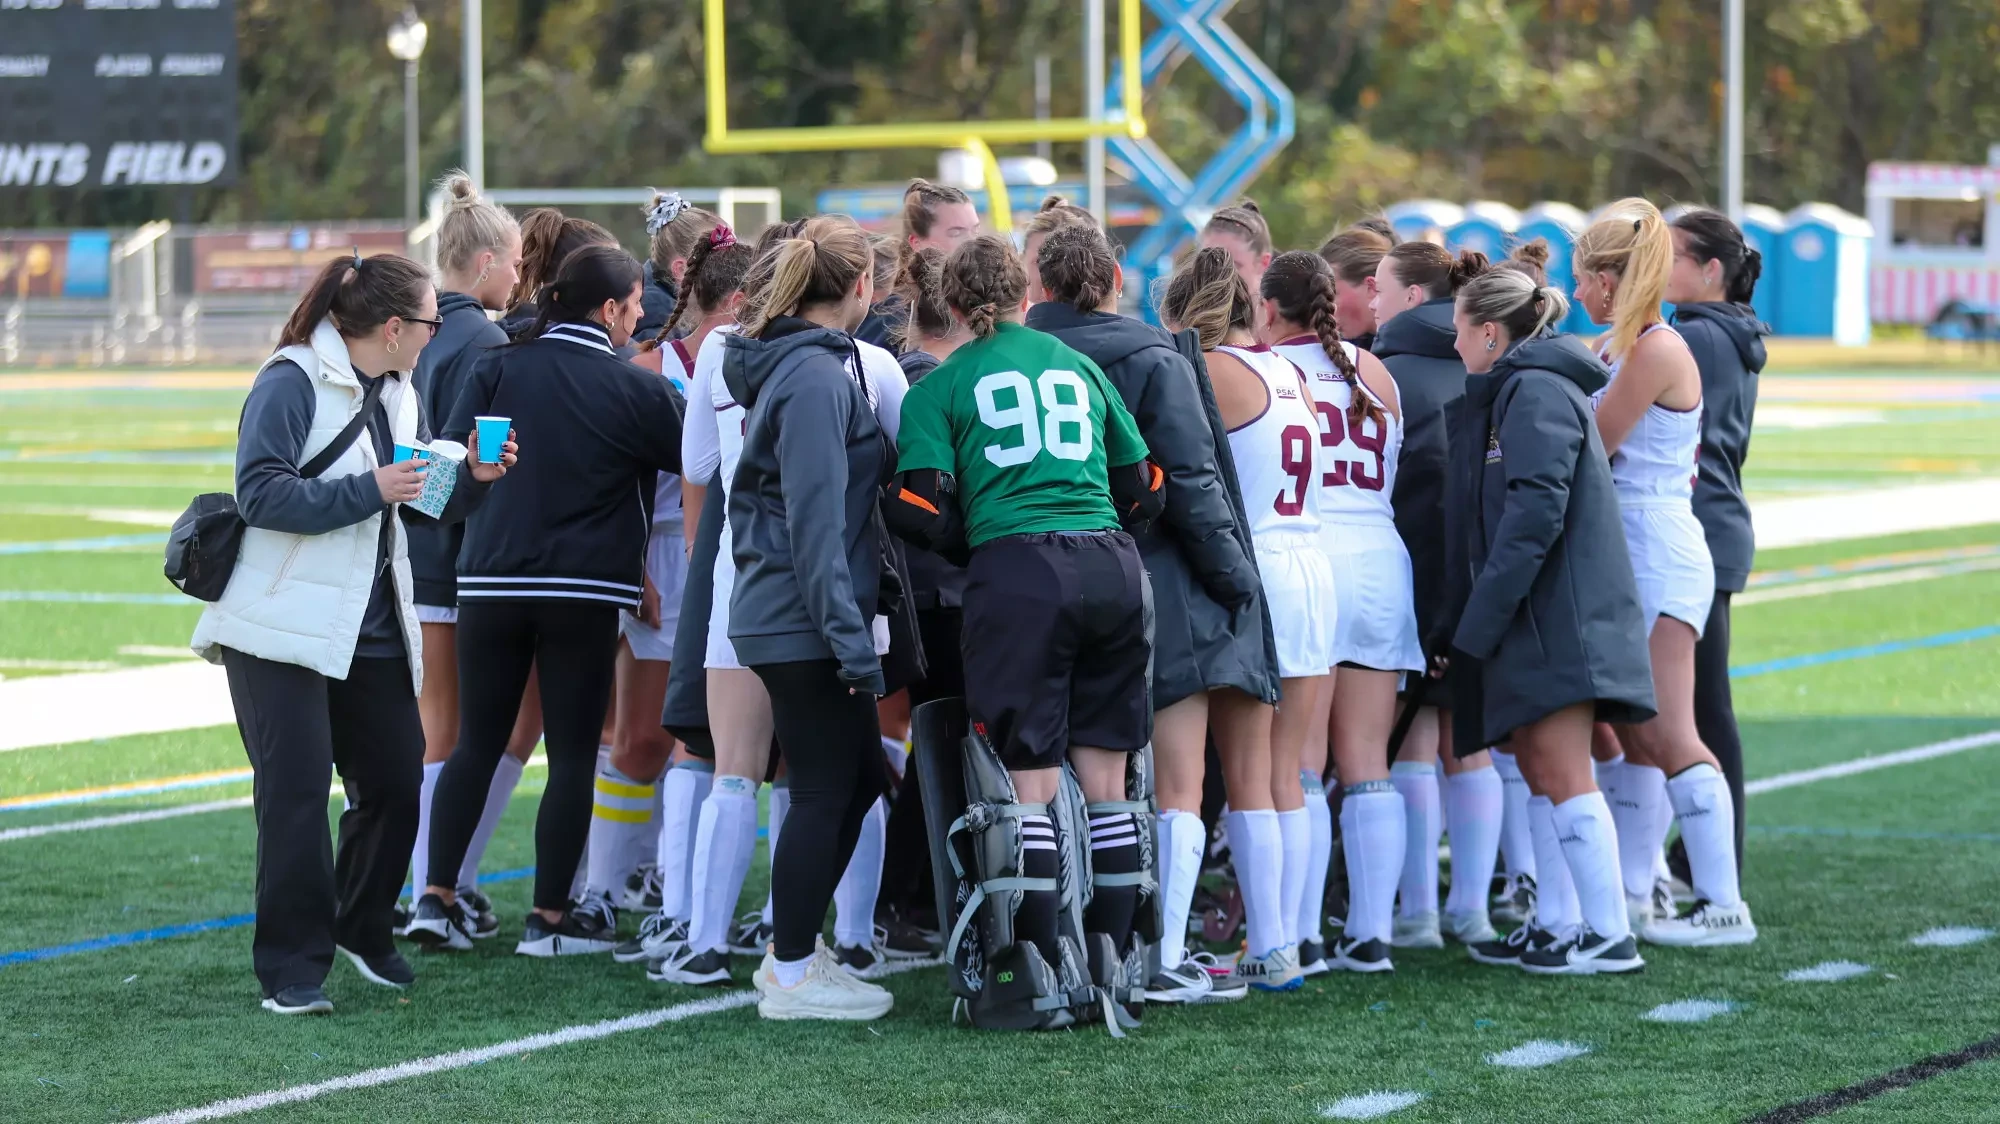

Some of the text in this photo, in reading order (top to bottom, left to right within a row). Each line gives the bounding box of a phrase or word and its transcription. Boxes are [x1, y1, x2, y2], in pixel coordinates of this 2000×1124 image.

[101, 141, 226, 186] FIELD
[974, 369, 1093, 469] 98
[1276, 388, 1296, 397] PSAC
[1273, 425, 1312, 516] 9
[1314, 401, 1387, 492] 29
